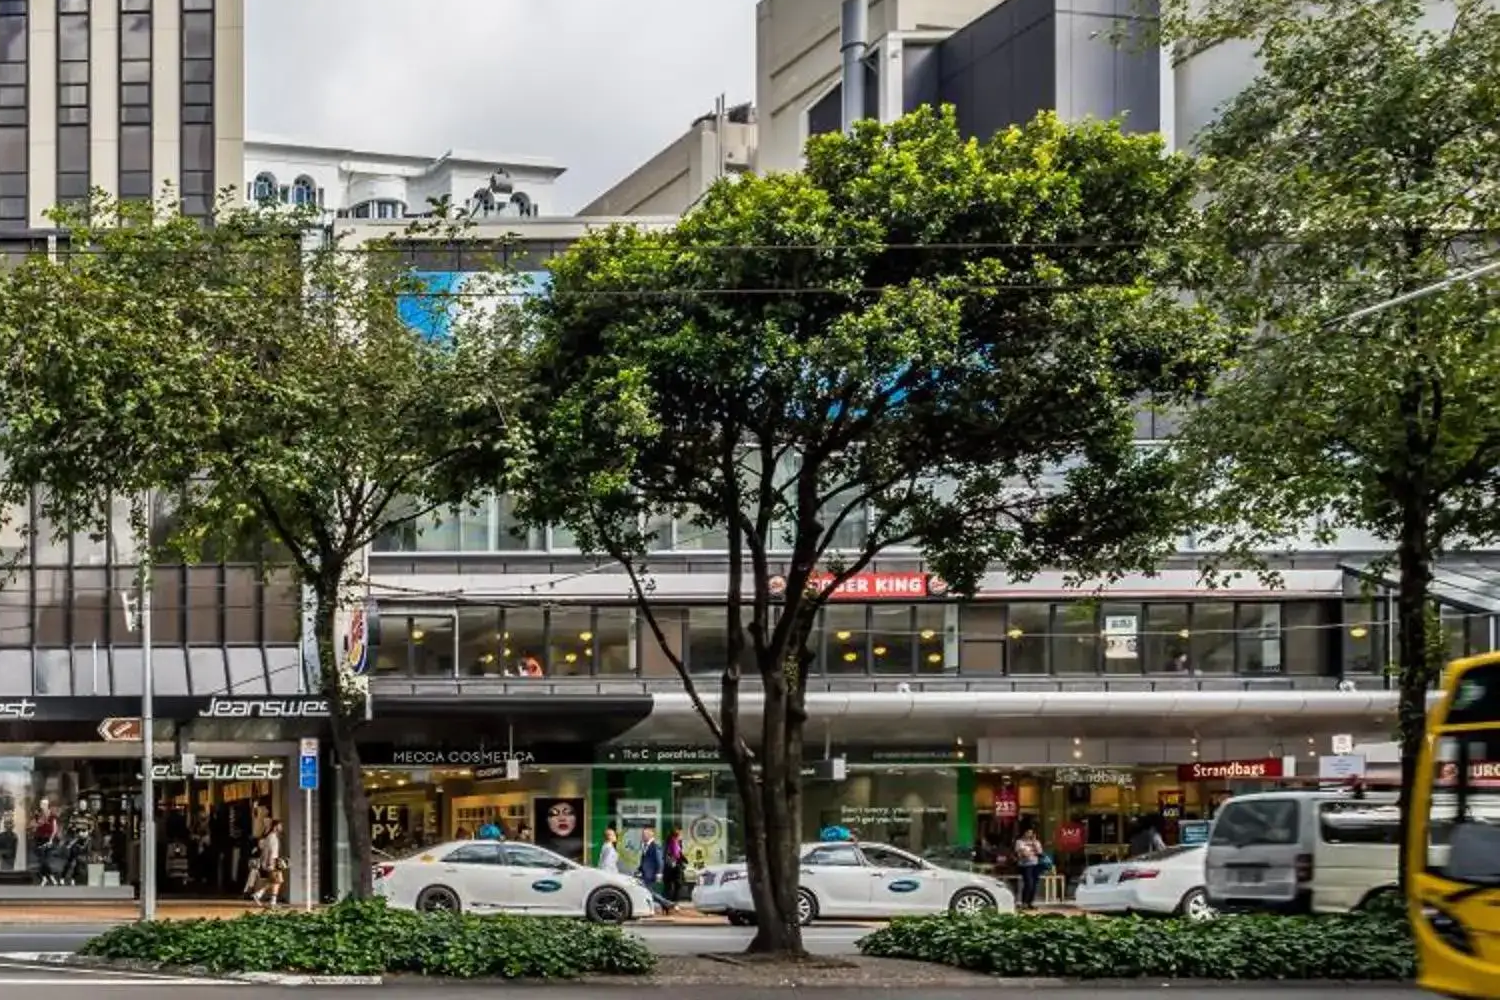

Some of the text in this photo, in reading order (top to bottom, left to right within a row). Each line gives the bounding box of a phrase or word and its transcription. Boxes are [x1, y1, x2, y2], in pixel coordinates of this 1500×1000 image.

[875, 577, 922, 592] KING
[393, 752, 535, 764] MECCA COSMETCA
[1193, 762, 1265, 778] Strandbags
